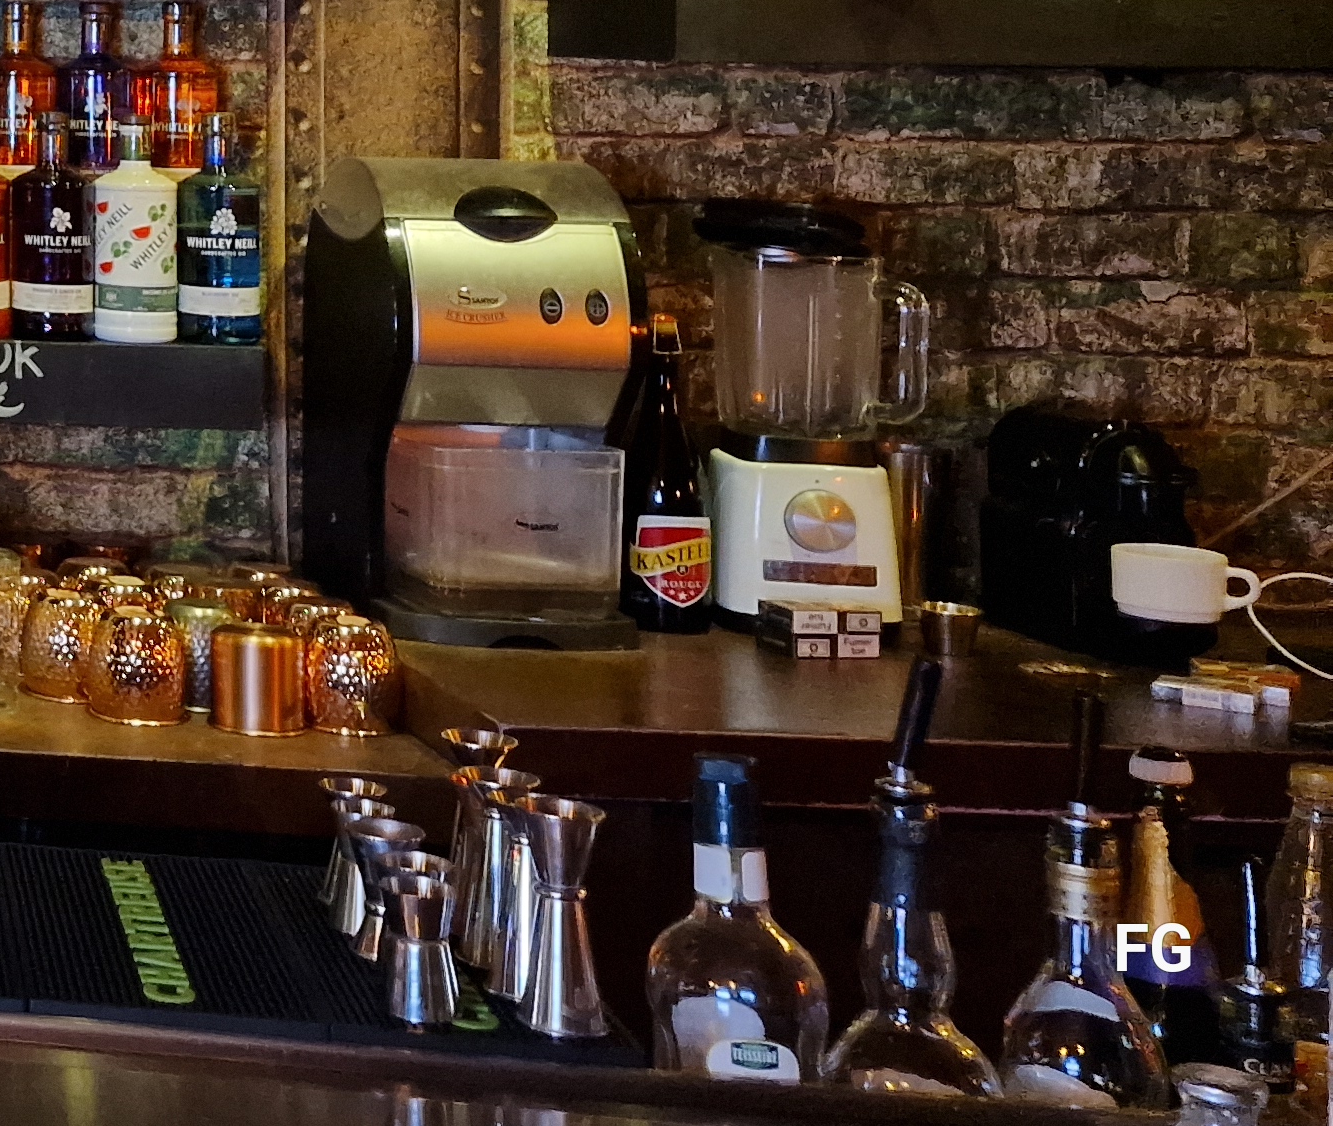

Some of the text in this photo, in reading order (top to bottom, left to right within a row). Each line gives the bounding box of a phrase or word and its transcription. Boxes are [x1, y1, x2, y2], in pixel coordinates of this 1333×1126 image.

[104, 202, 133, 230] NEILL
[24, 234, 72, 247] WHITLEY
[186, 236, 258, 249] WHITLEY NEILL
[462, 311, 509, 324] CRUSHER
[660, 578, 703, 590] ROUGE
[100, 856, 197, 1006] CHARTREUSE
